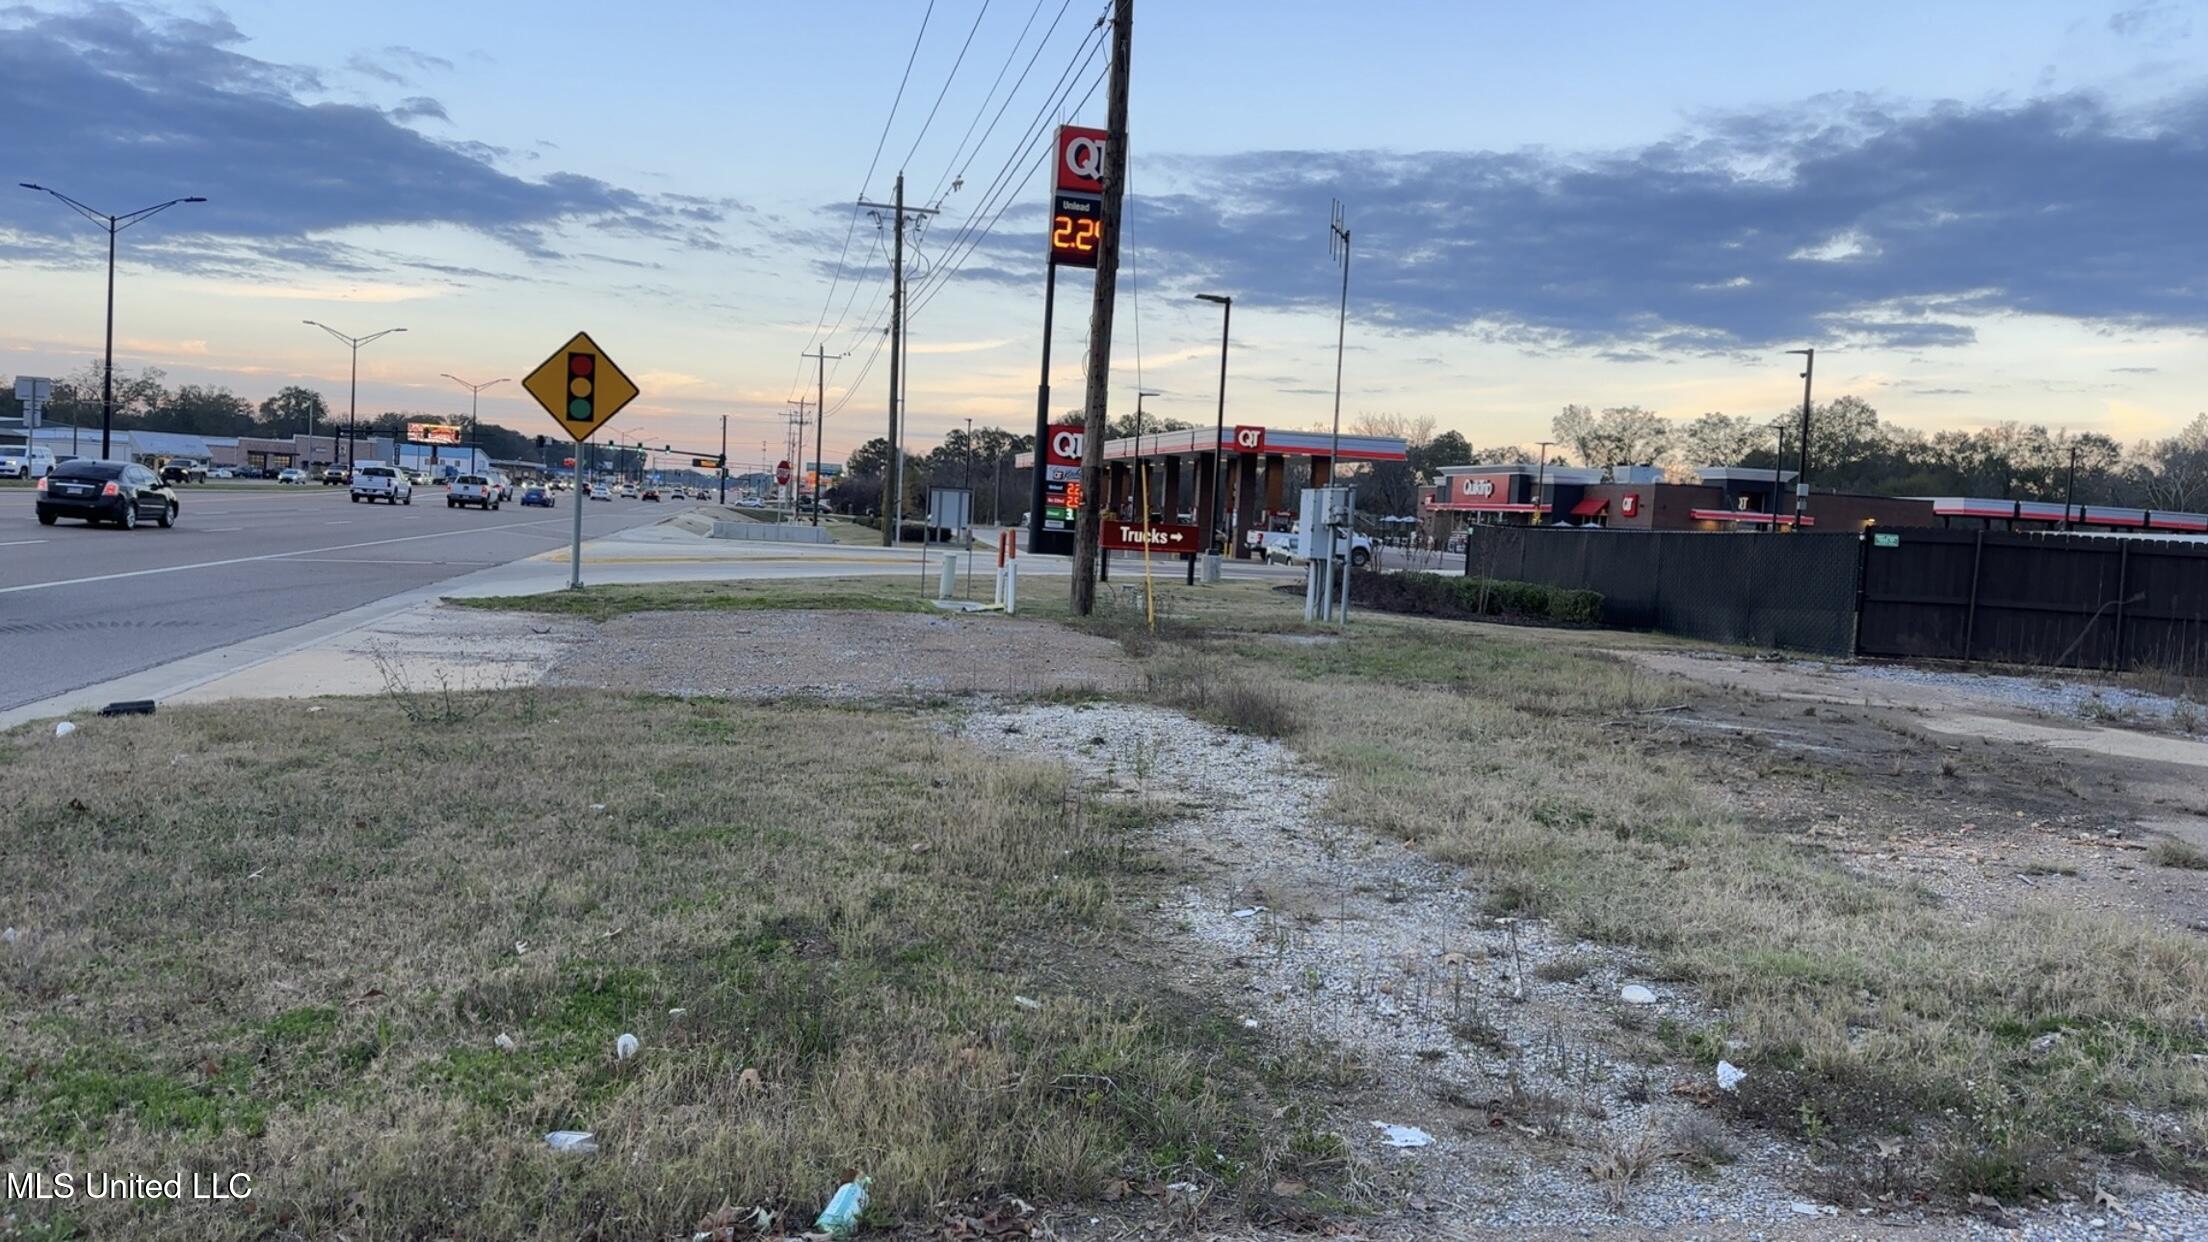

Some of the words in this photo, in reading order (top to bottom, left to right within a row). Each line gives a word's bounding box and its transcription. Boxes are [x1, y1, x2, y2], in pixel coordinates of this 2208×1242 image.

[1063, 200, 1090, 212] Unlead
[1053, 431, 1083, 459] QT
[1238, 429, 1261, 448] QT
[1120, 526, 1168, 544] Trucks
